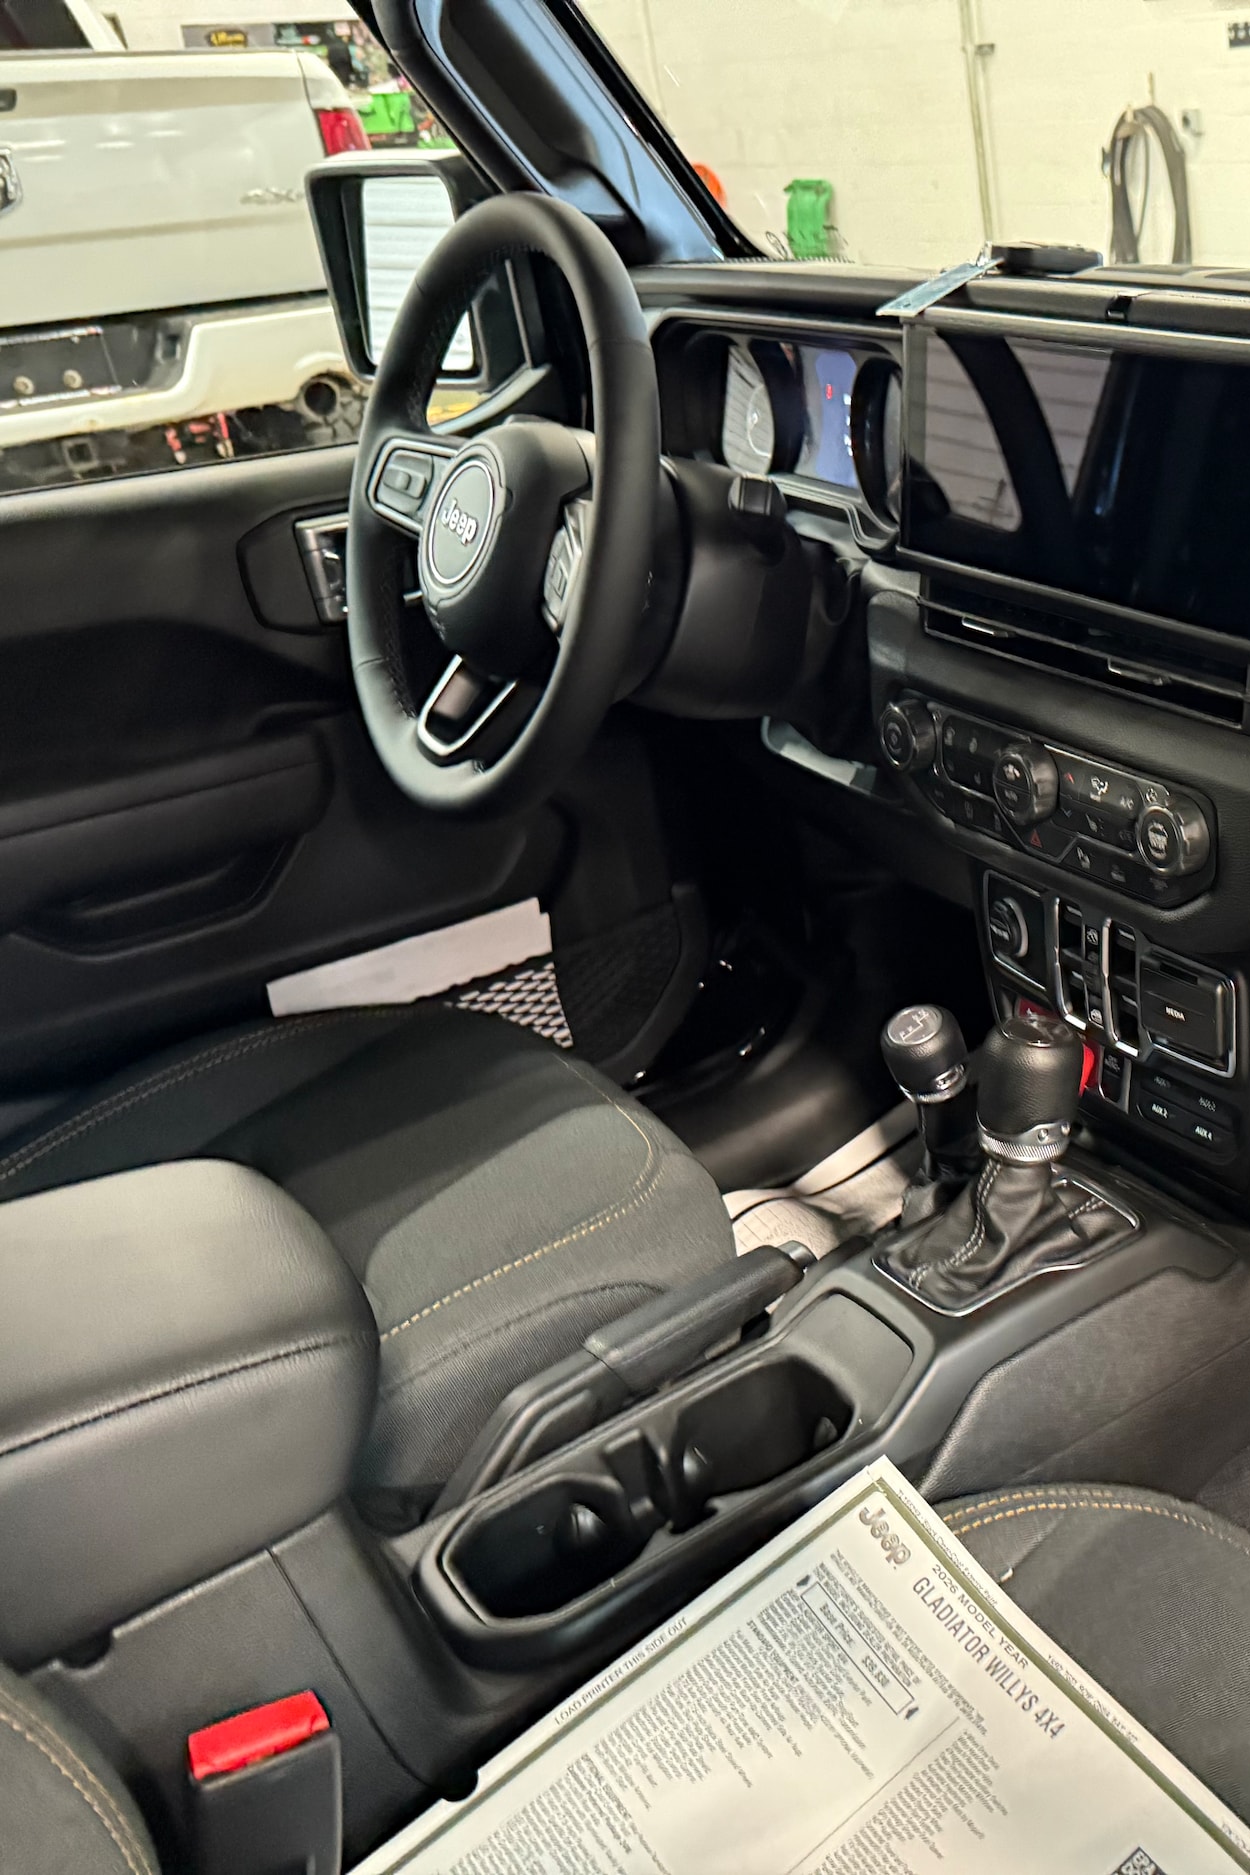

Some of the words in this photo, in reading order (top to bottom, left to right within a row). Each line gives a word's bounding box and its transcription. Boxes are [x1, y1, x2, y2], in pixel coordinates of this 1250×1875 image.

[441, 498, 479, 546] Jeep
[1165, 1006, 1186, 1022] MEDIA
[1194, 1125, 1208, 1138] AUX
[859, 1506, 911, 1566] Jeep
[819, 1602, 837, 1625] Base
[931, 1564, 958, 1593] 2026
[957, 1593, 995, 1638] MODEL
[999, 1636, 1028, 1669] YEAR
[554, 1700, 581, 1725] LOAD
[581, 1667, 622, 1703] PRINTER
[622, 1651, 645, 1669] THIS
[644, 1634, 664, 1652] SIDE
[667, 1616, 686, 1636] OUT
[913, 1577, 989, 1661] GLADIATOR
[985, 1656, 1038, 1711] WILLYS
[1034, 1708, 1064, 1738] 4X4
